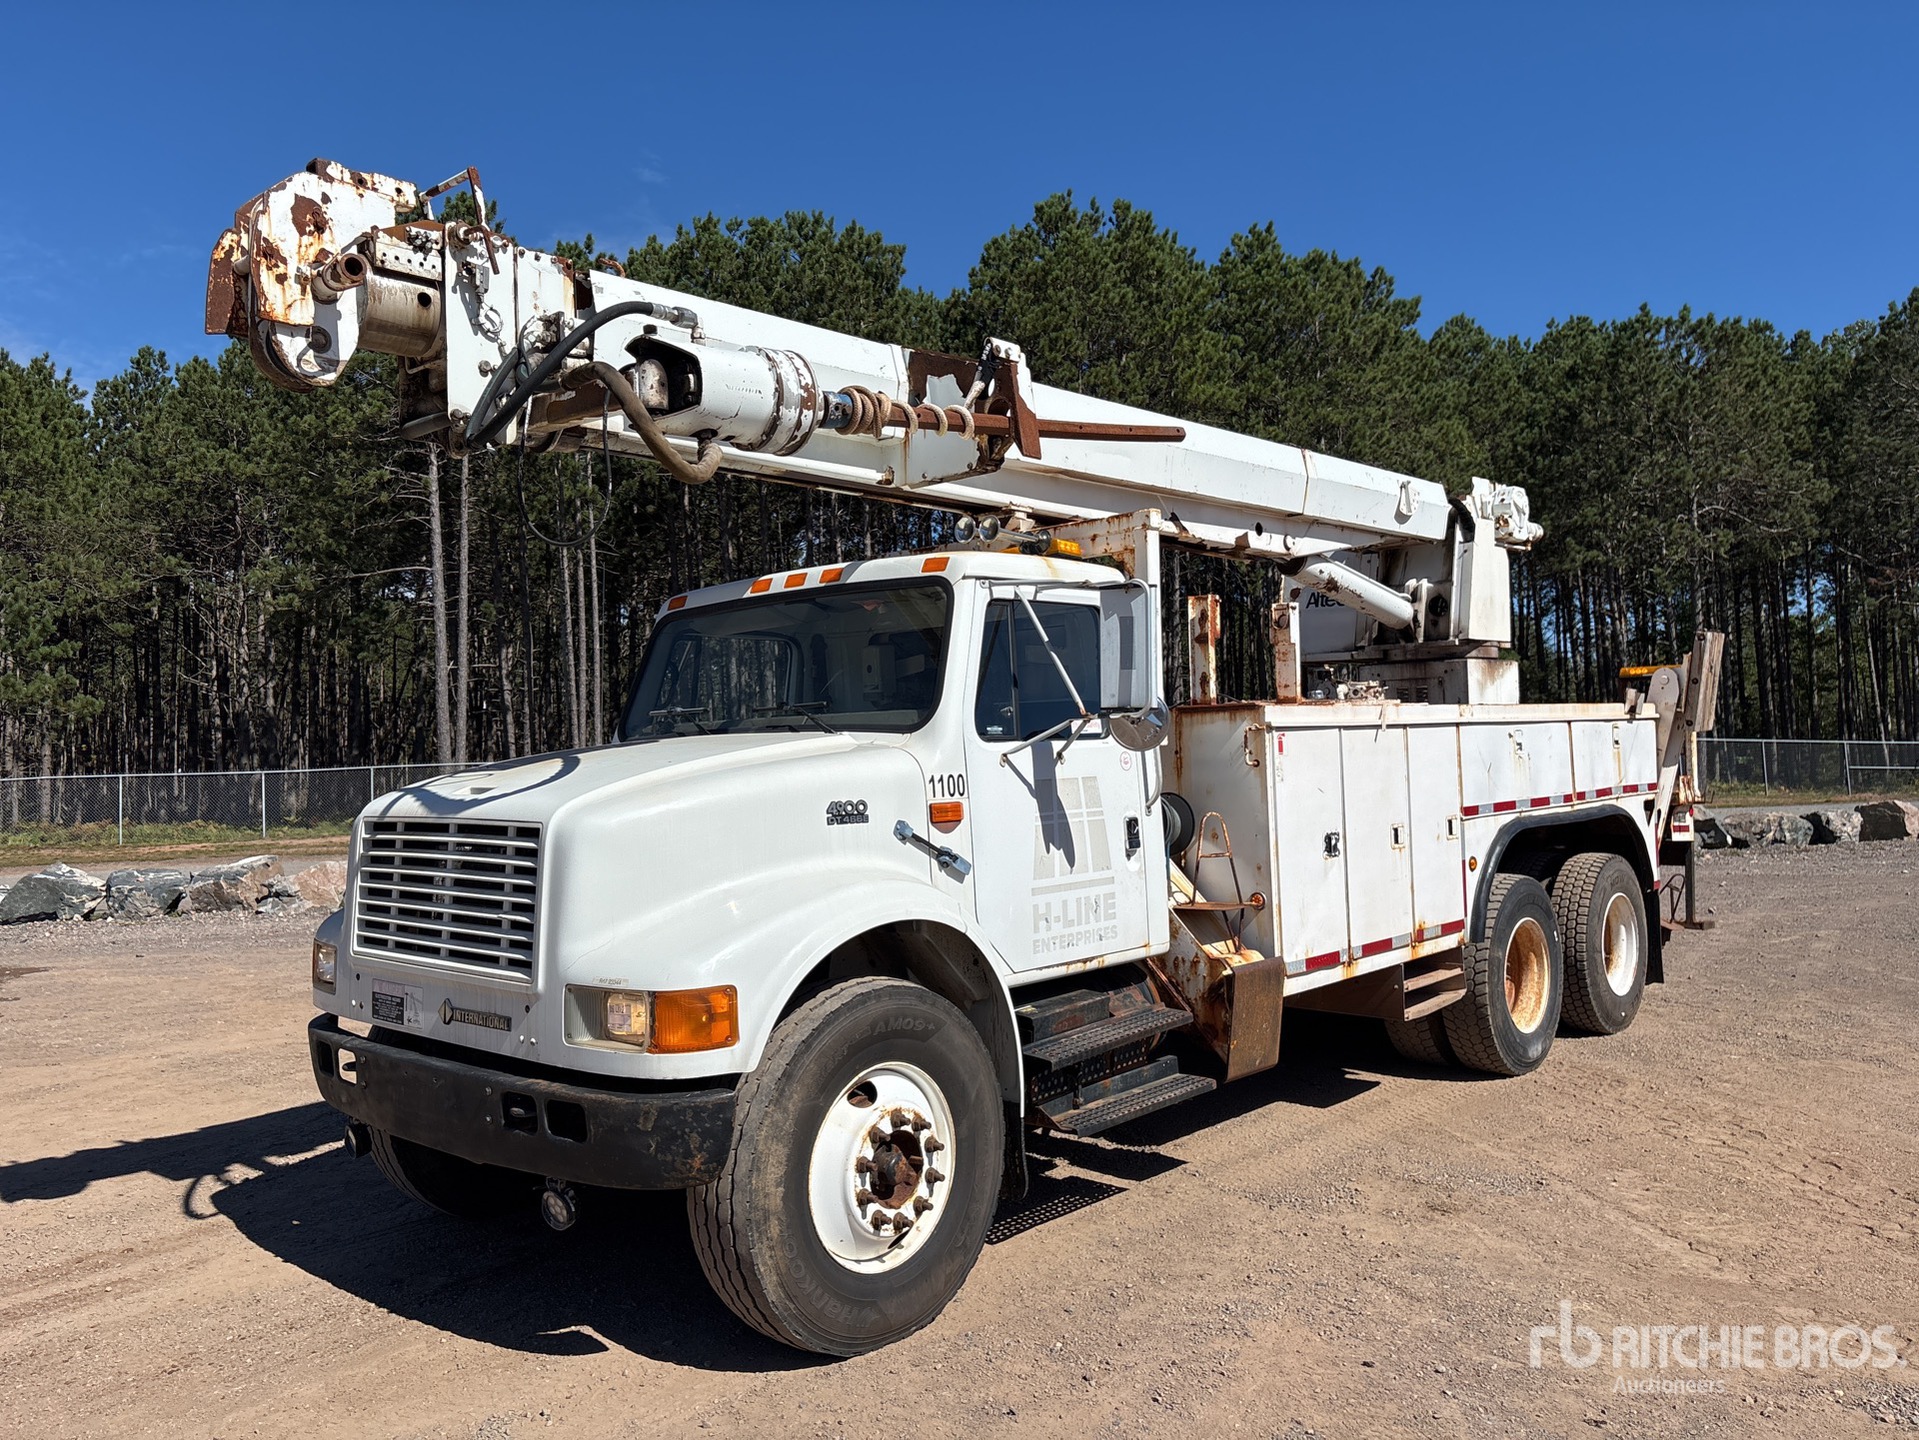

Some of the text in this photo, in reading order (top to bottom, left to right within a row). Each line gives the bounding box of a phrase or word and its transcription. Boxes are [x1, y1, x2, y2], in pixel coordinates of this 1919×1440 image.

[928, 773, 966, 798] 1100
[826, 799, 868, 815] 4900
[1032, 892, 1116, 933] H-LINE
[1032, 924, 1118, 955] ENTERPRISES
[452, 1008, 508, 1031] INTERNATIONAL
